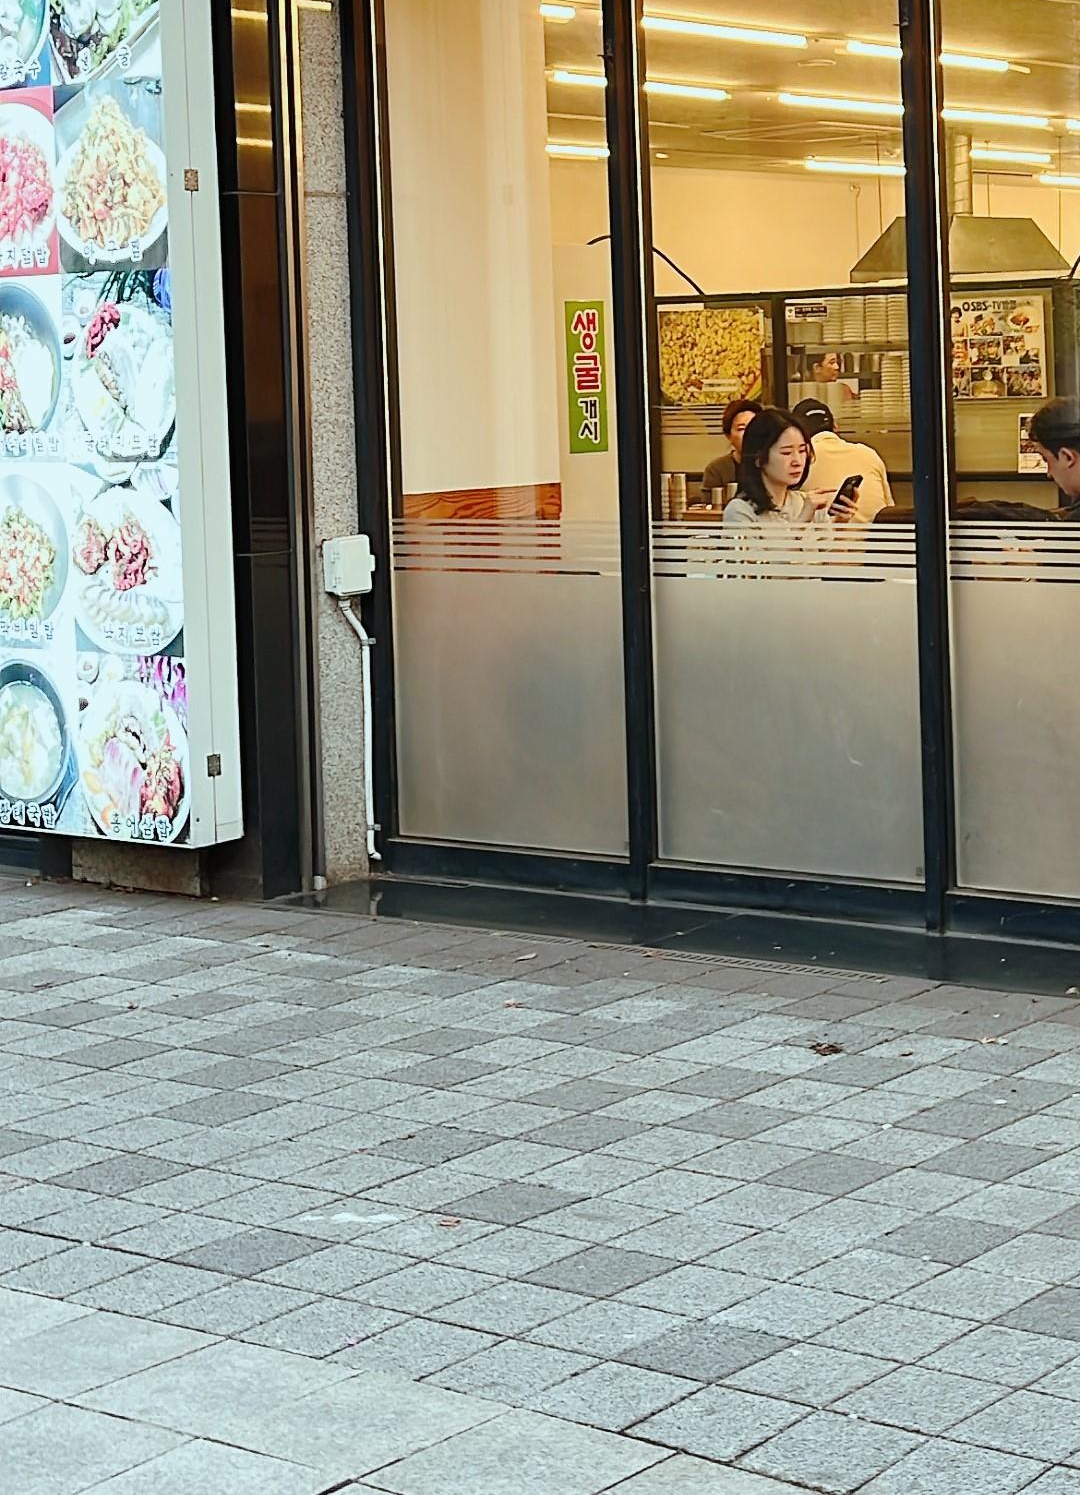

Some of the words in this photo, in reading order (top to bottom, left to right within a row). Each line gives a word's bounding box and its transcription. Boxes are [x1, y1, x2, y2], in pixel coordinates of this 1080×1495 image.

[571, 309, 602, 393] 생굴
[578, 397, 601, 444] 개시
[110, 812, 171, 841] 홍어삼합
